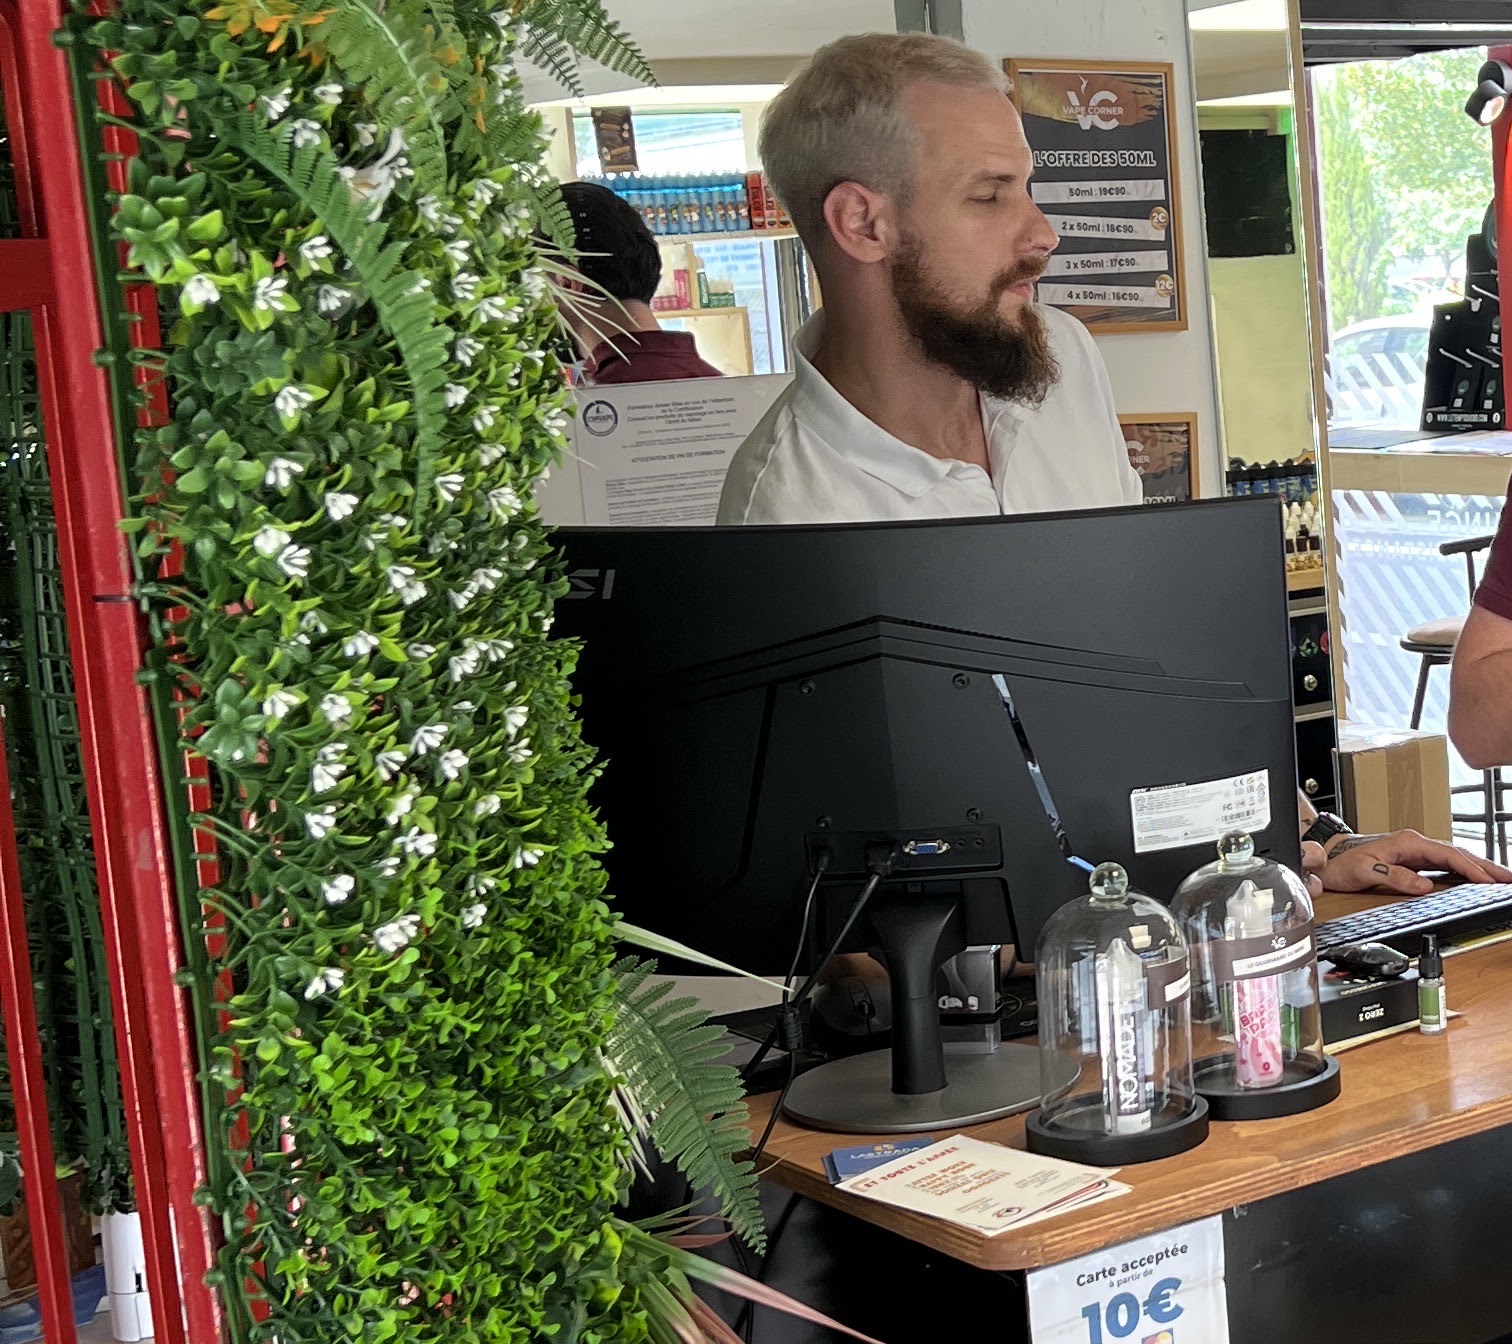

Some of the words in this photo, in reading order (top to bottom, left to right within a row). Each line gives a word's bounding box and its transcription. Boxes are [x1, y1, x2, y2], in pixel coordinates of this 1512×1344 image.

[1062, 106, 1085, 115] VAPE
[1088, 106, 1124, 116] CORNER
[1034, 151, 1089, 167] L'OFFRE
[1091, 151, 1117, 166] DES
[1119, 151, 1156, 167] 50ML
[564, 569, 616, 599] SI
[1116, 1013, 1139, 1110] NOMADE
[1076, 1266, 1118, 1287] Carte
[1121, 1242, 1189, 1272] acceptée
[1116, 1271, 1141, 1289] partir
[1143, 1267, 1154, 1278] de
